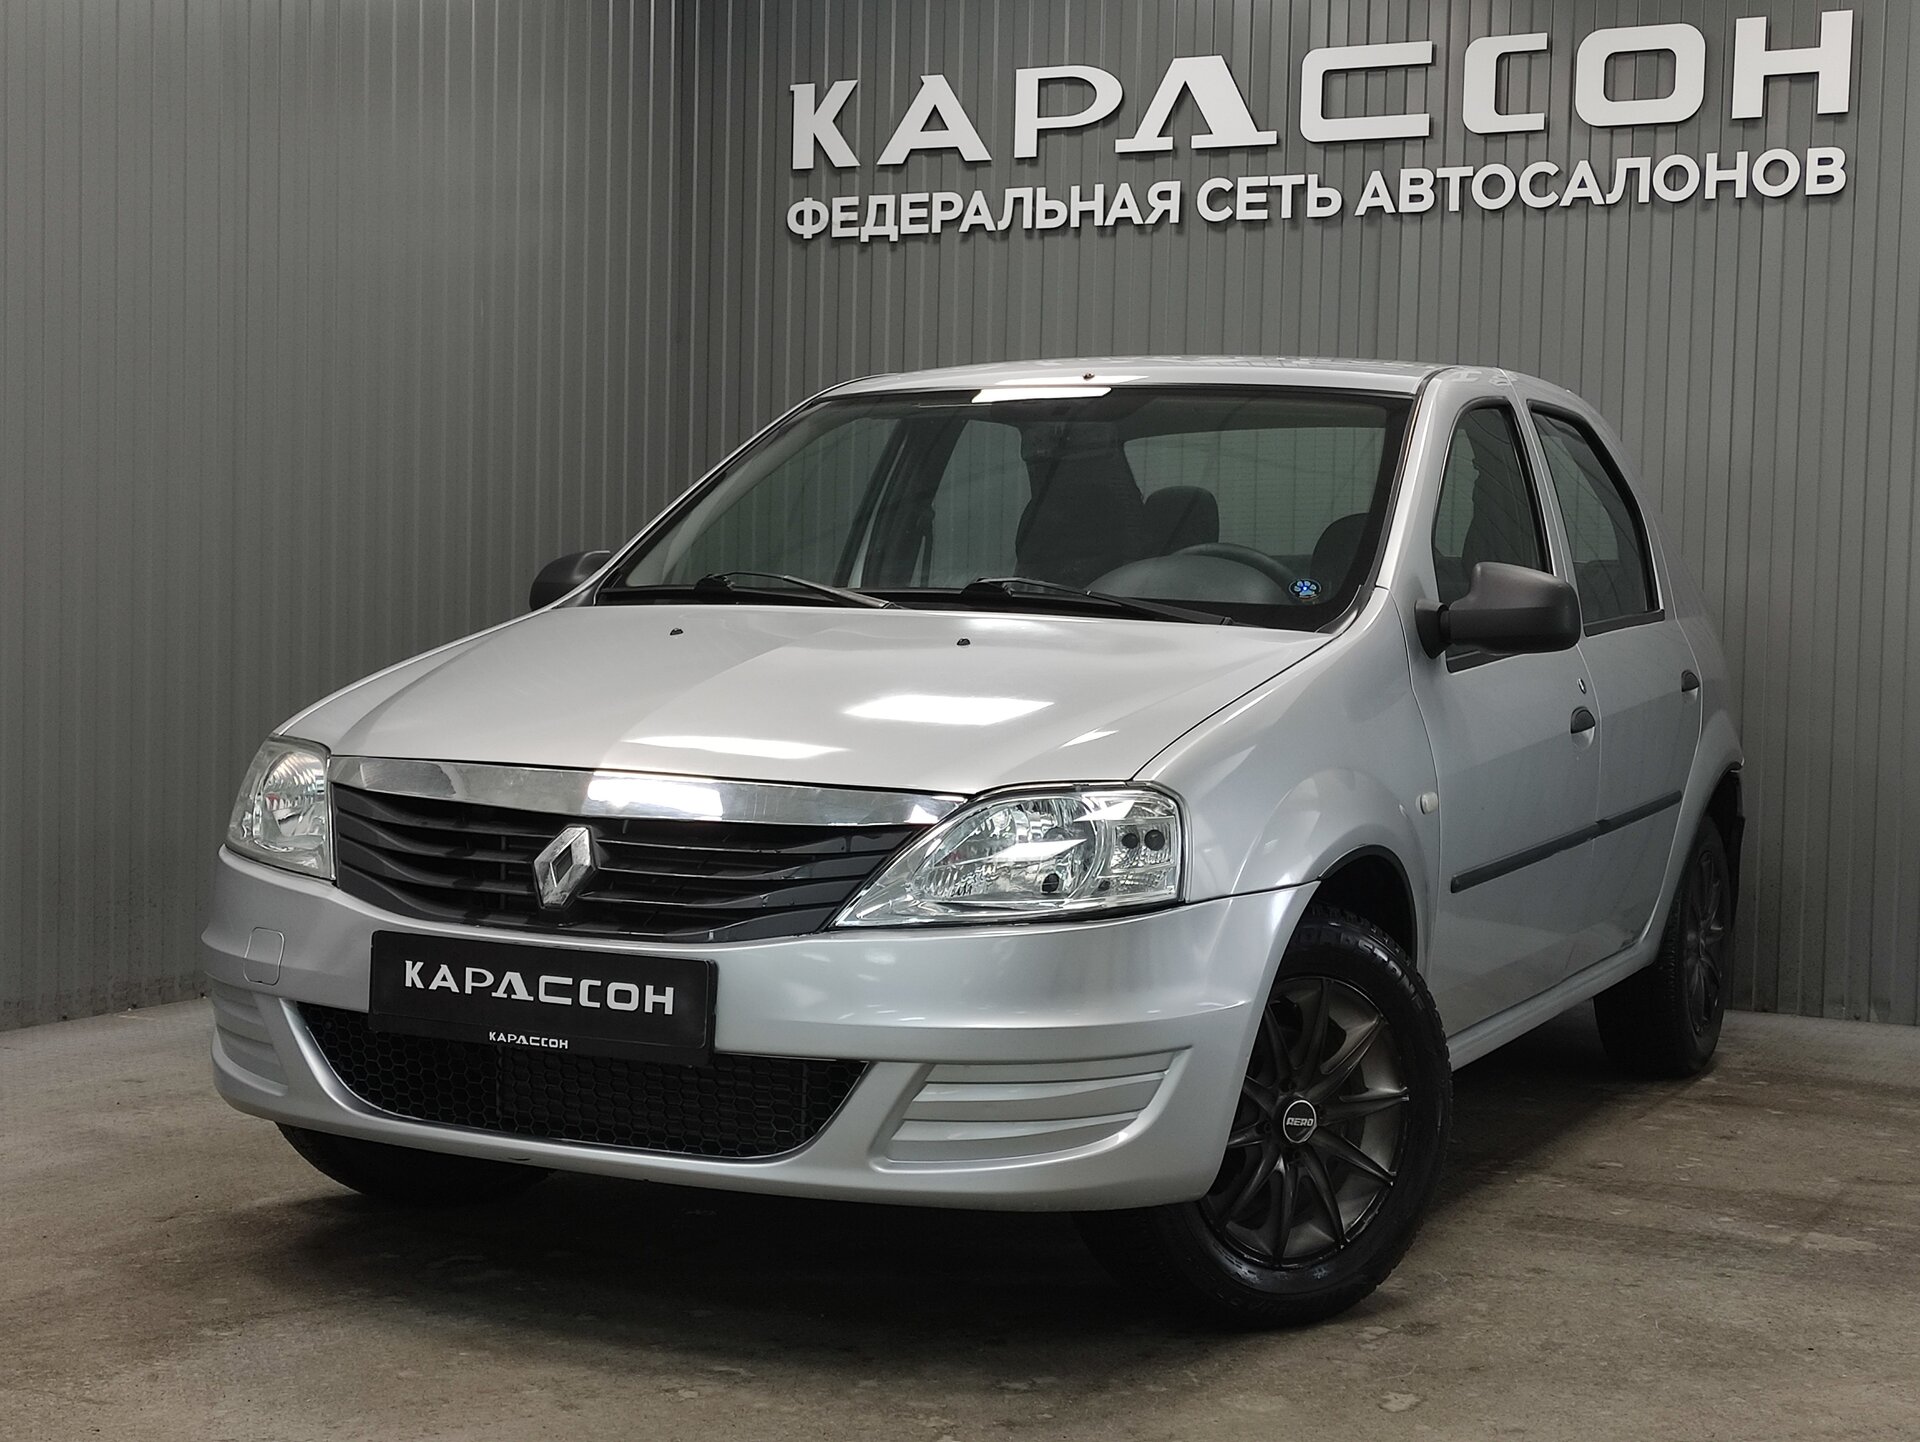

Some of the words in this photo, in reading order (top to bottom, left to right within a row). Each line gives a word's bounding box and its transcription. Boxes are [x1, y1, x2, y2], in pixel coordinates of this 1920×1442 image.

[787, 180, 1181, 242] ФЕДЕРАЛЬНАЯ
[1196, 174, 1342, 222] СЕТЬ
[1355, 146, 1847, 217] АВТОСАЛОНОВ
[1286, 1117, 1314, 1127] AERO
